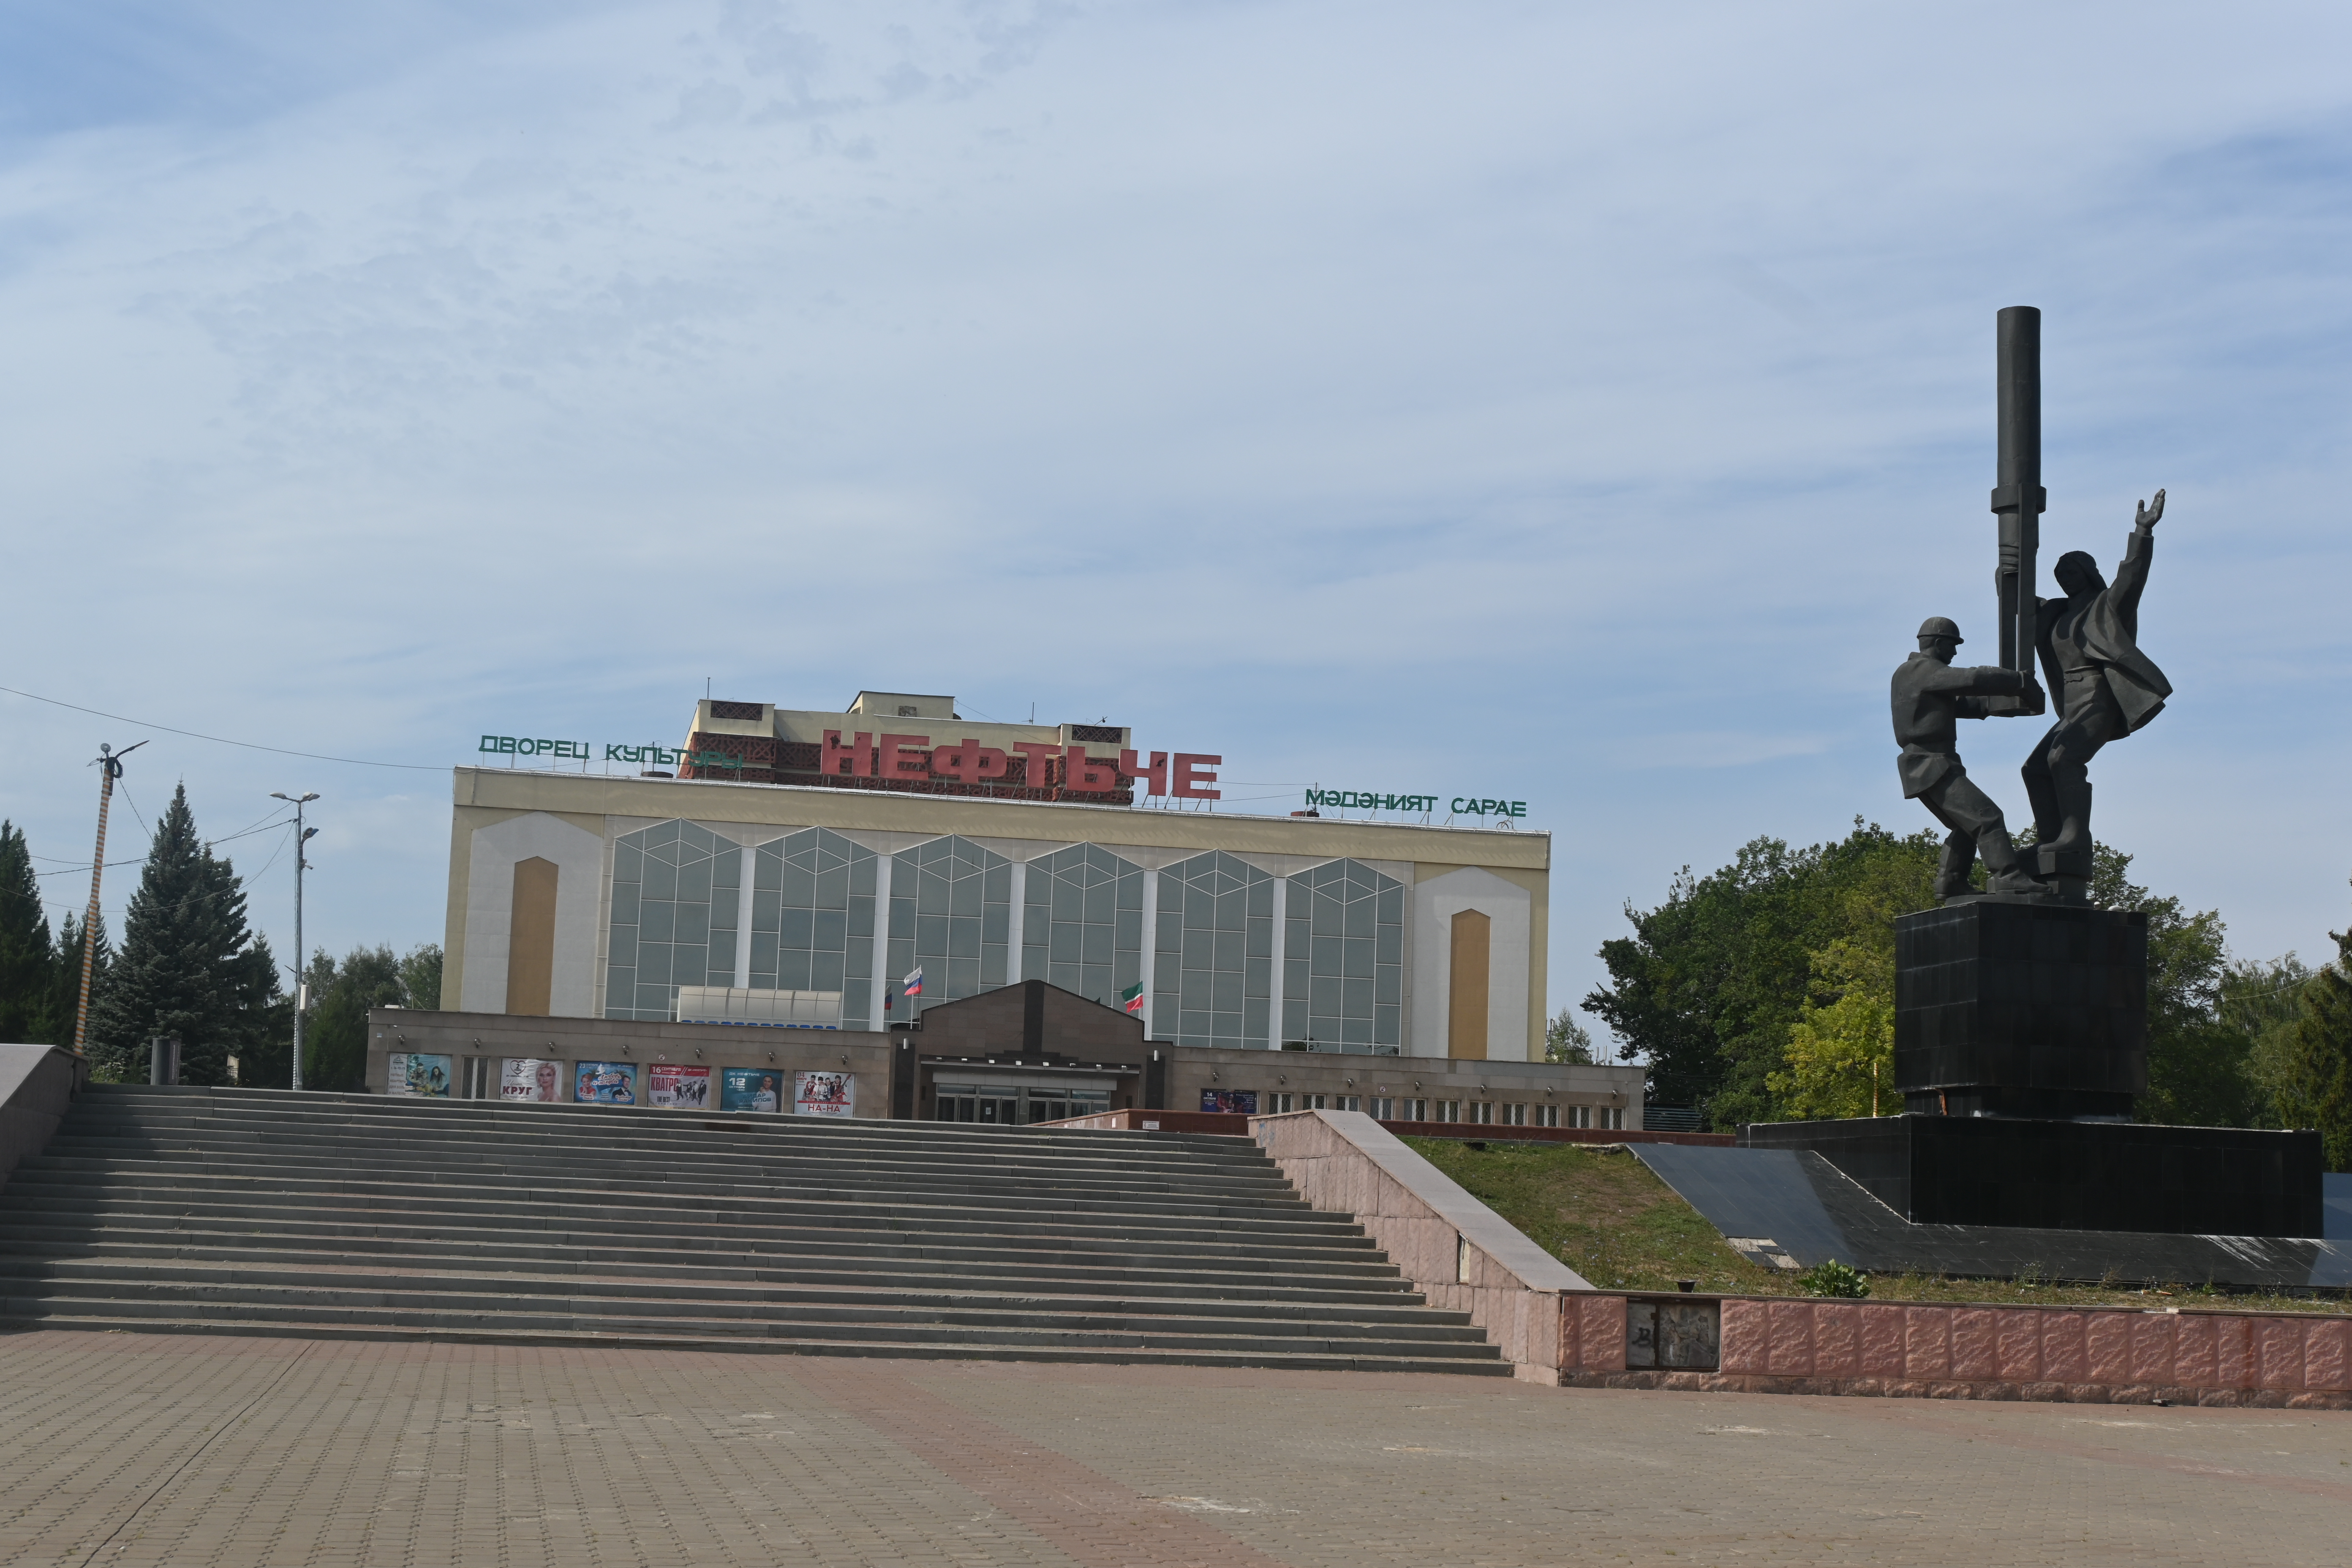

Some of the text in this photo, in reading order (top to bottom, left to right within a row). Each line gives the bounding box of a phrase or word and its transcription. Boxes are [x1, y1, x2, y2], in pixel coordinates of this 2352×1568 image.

[478, 735, 743, 770] ДВОРЕЦ КУЛЬТУРЫ
[820, 729, 1222, 800] НЕФТЬЧЕ
[1306, 789, 1527, 817] МӘДӘНИЯТ САРАЕ
[651, 1077, 679, 1092] КВАТРО
[729, 1078, 746, 1086] 12
[502, 1086, 532, 1095] КРУГ
[808, 1104, 841, 1113] НА-НА
